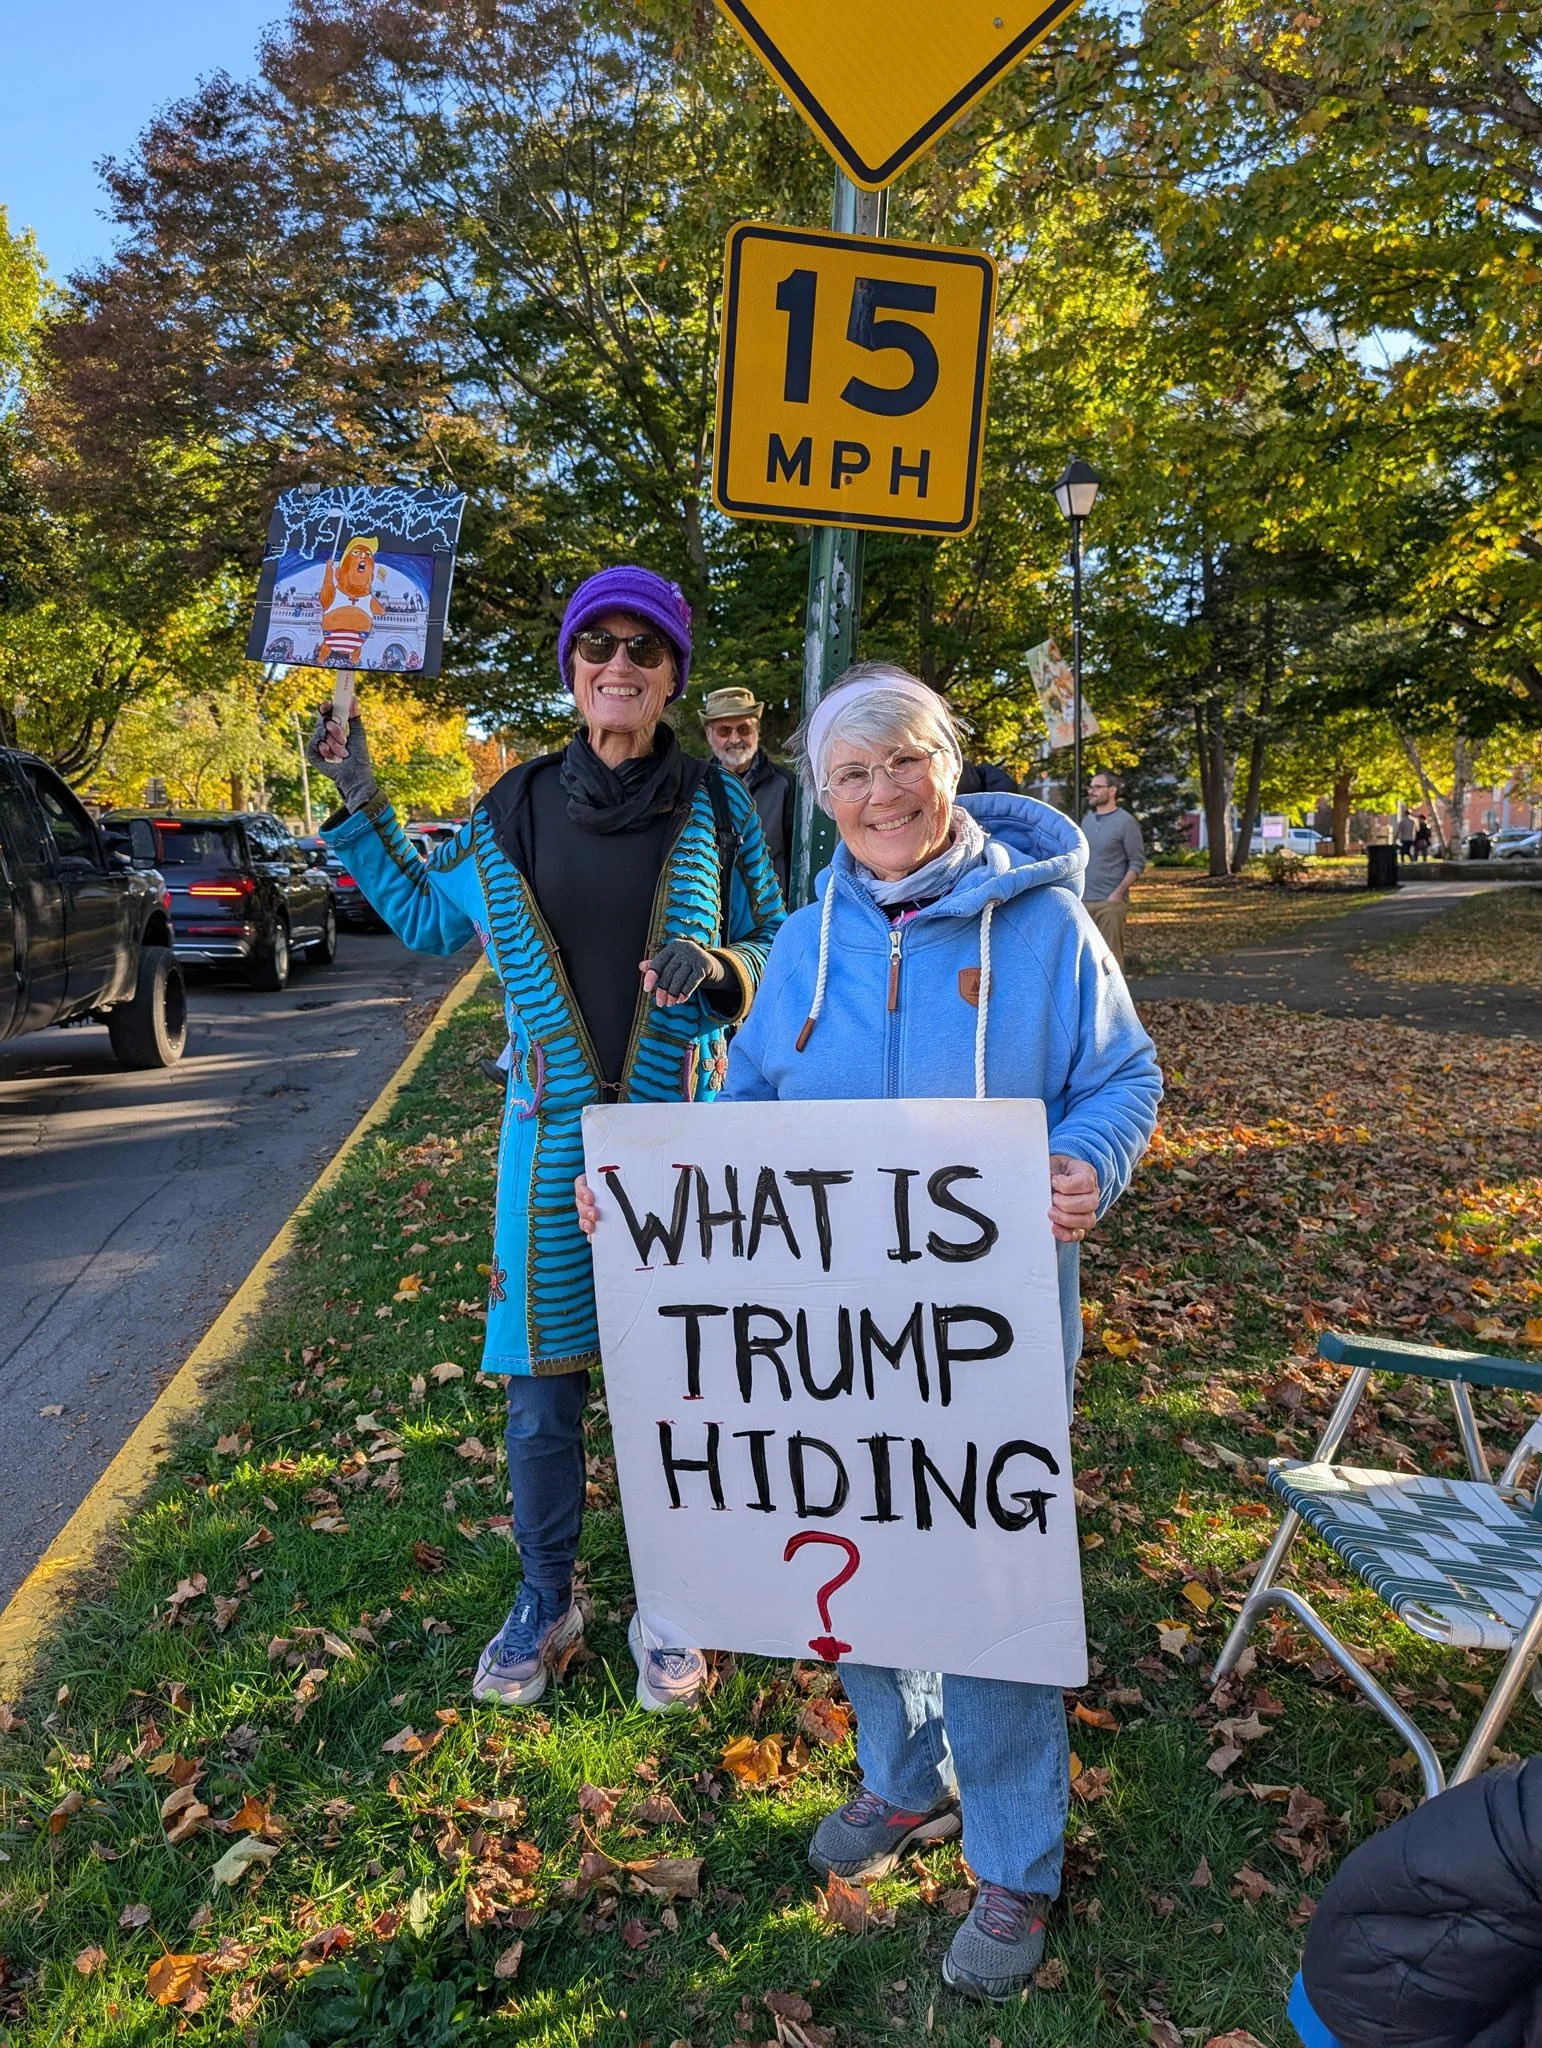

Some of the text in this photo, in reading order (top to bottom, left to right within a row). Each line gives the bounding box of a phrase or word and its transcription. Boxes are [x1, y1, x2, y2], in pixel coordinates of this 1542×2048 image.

[775, 268, 940, 417] 15
[766, 432, 931, 499] MPH
[597, 1163, 1000, 1273] WHAT IS
[658, 1301, 1015, 1407] TRUMP
[655, 1419, 1061, 1535] HIDING
[783, 1529, 861, 1663] ?
